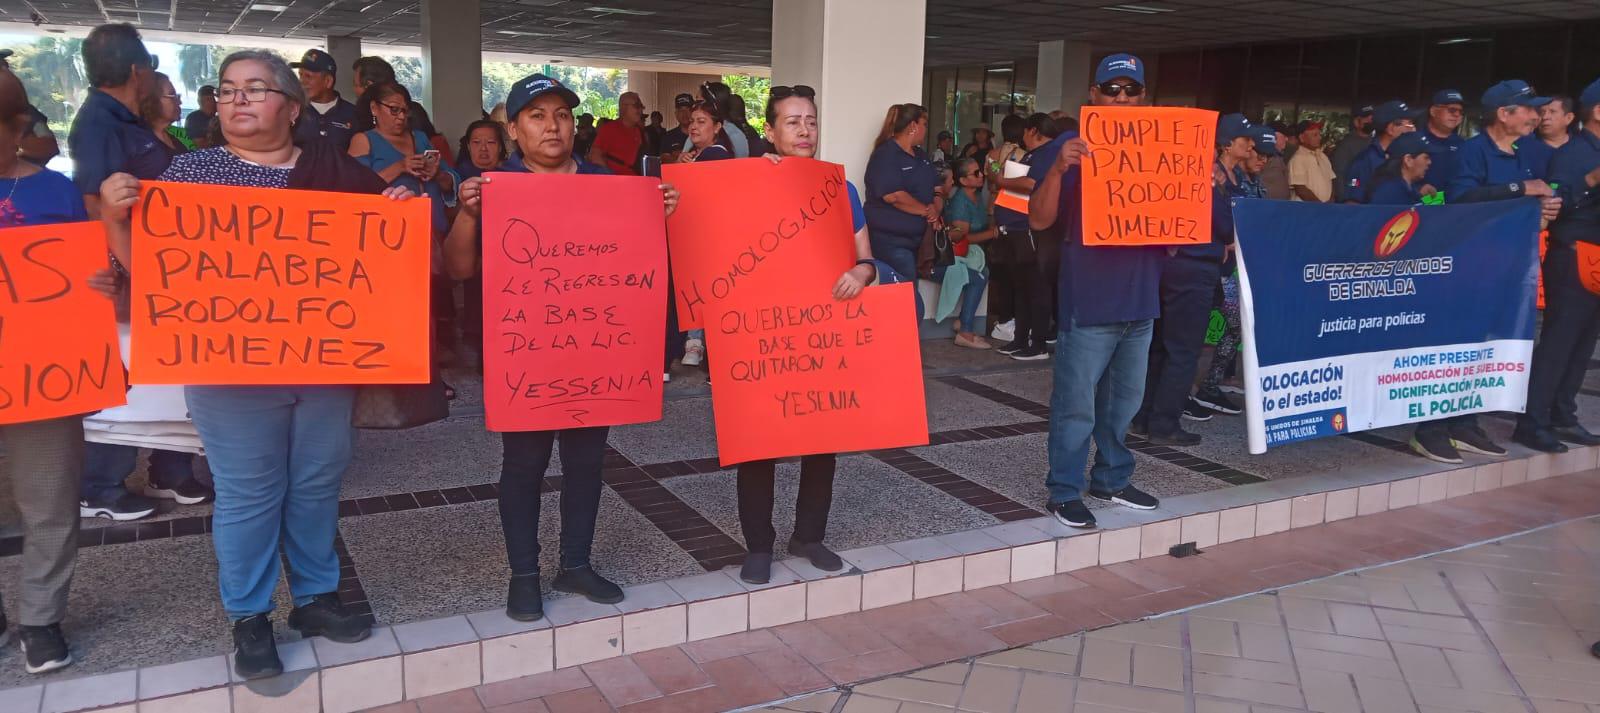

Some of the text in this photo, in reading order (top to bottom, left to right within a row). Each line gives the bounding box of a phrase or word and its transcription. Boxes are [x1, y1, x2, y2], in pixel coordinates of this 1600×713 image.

[1085, 111, 1209, 149] CUMPLE TU
[1090, 147, 1206, 178] PALABRA
[1105, 179, 1207, 209] RODOLFO
[141, 186, 407, 252] CUMPLE TU
[1094, 213, 1199, 241] JIMENEZ
[502, 217, 619, 268] QUEREMOS
[681, 166, 845, 323] HOMOLOGACIÓN
[155, 247, 373, 295] PALABRA
[1304, 256, 1453, 282] GUERREROS UNIDOS
[501, 275, 534, 296] LE
[1329, 278, 1416, 301] DE SINALOA
[145, 293, 357, 330] RODOLFO
[501, 304, 626, 326] LA BASE
[720, 302, 868, 335] QUEREMOS LA
[1317, 316, 1357, 338] justicia
[1358, 315, 1383, 334] para
[156, 333, 391, 370] JIMENEZ
[502, 332, 543, 357] DE
[551, 334, 579, 350] LA
[758, 327, 874, 355] BASE QUE LE
[837, 355, 848, 370] A
[1393, 347, 1494, 369] AHOME PRESENTE
[1261, 363, 1344, 392] OLOGACIÓN
[1378, 362, 1525, 385] HOMOLOGACIÓN DE SUELDOS
[505, 370, 653, 407] YESSENIA
[1278, 393, 1291, 409] el
[1294, 386, 1342, 407] estado!
[1389, 376, 1505, 401] DIGNIFICACIÓN PARA
[774, 389, 861, 419] YESENIA
[1408, 391, 1483, 418] EL POLICÍA
